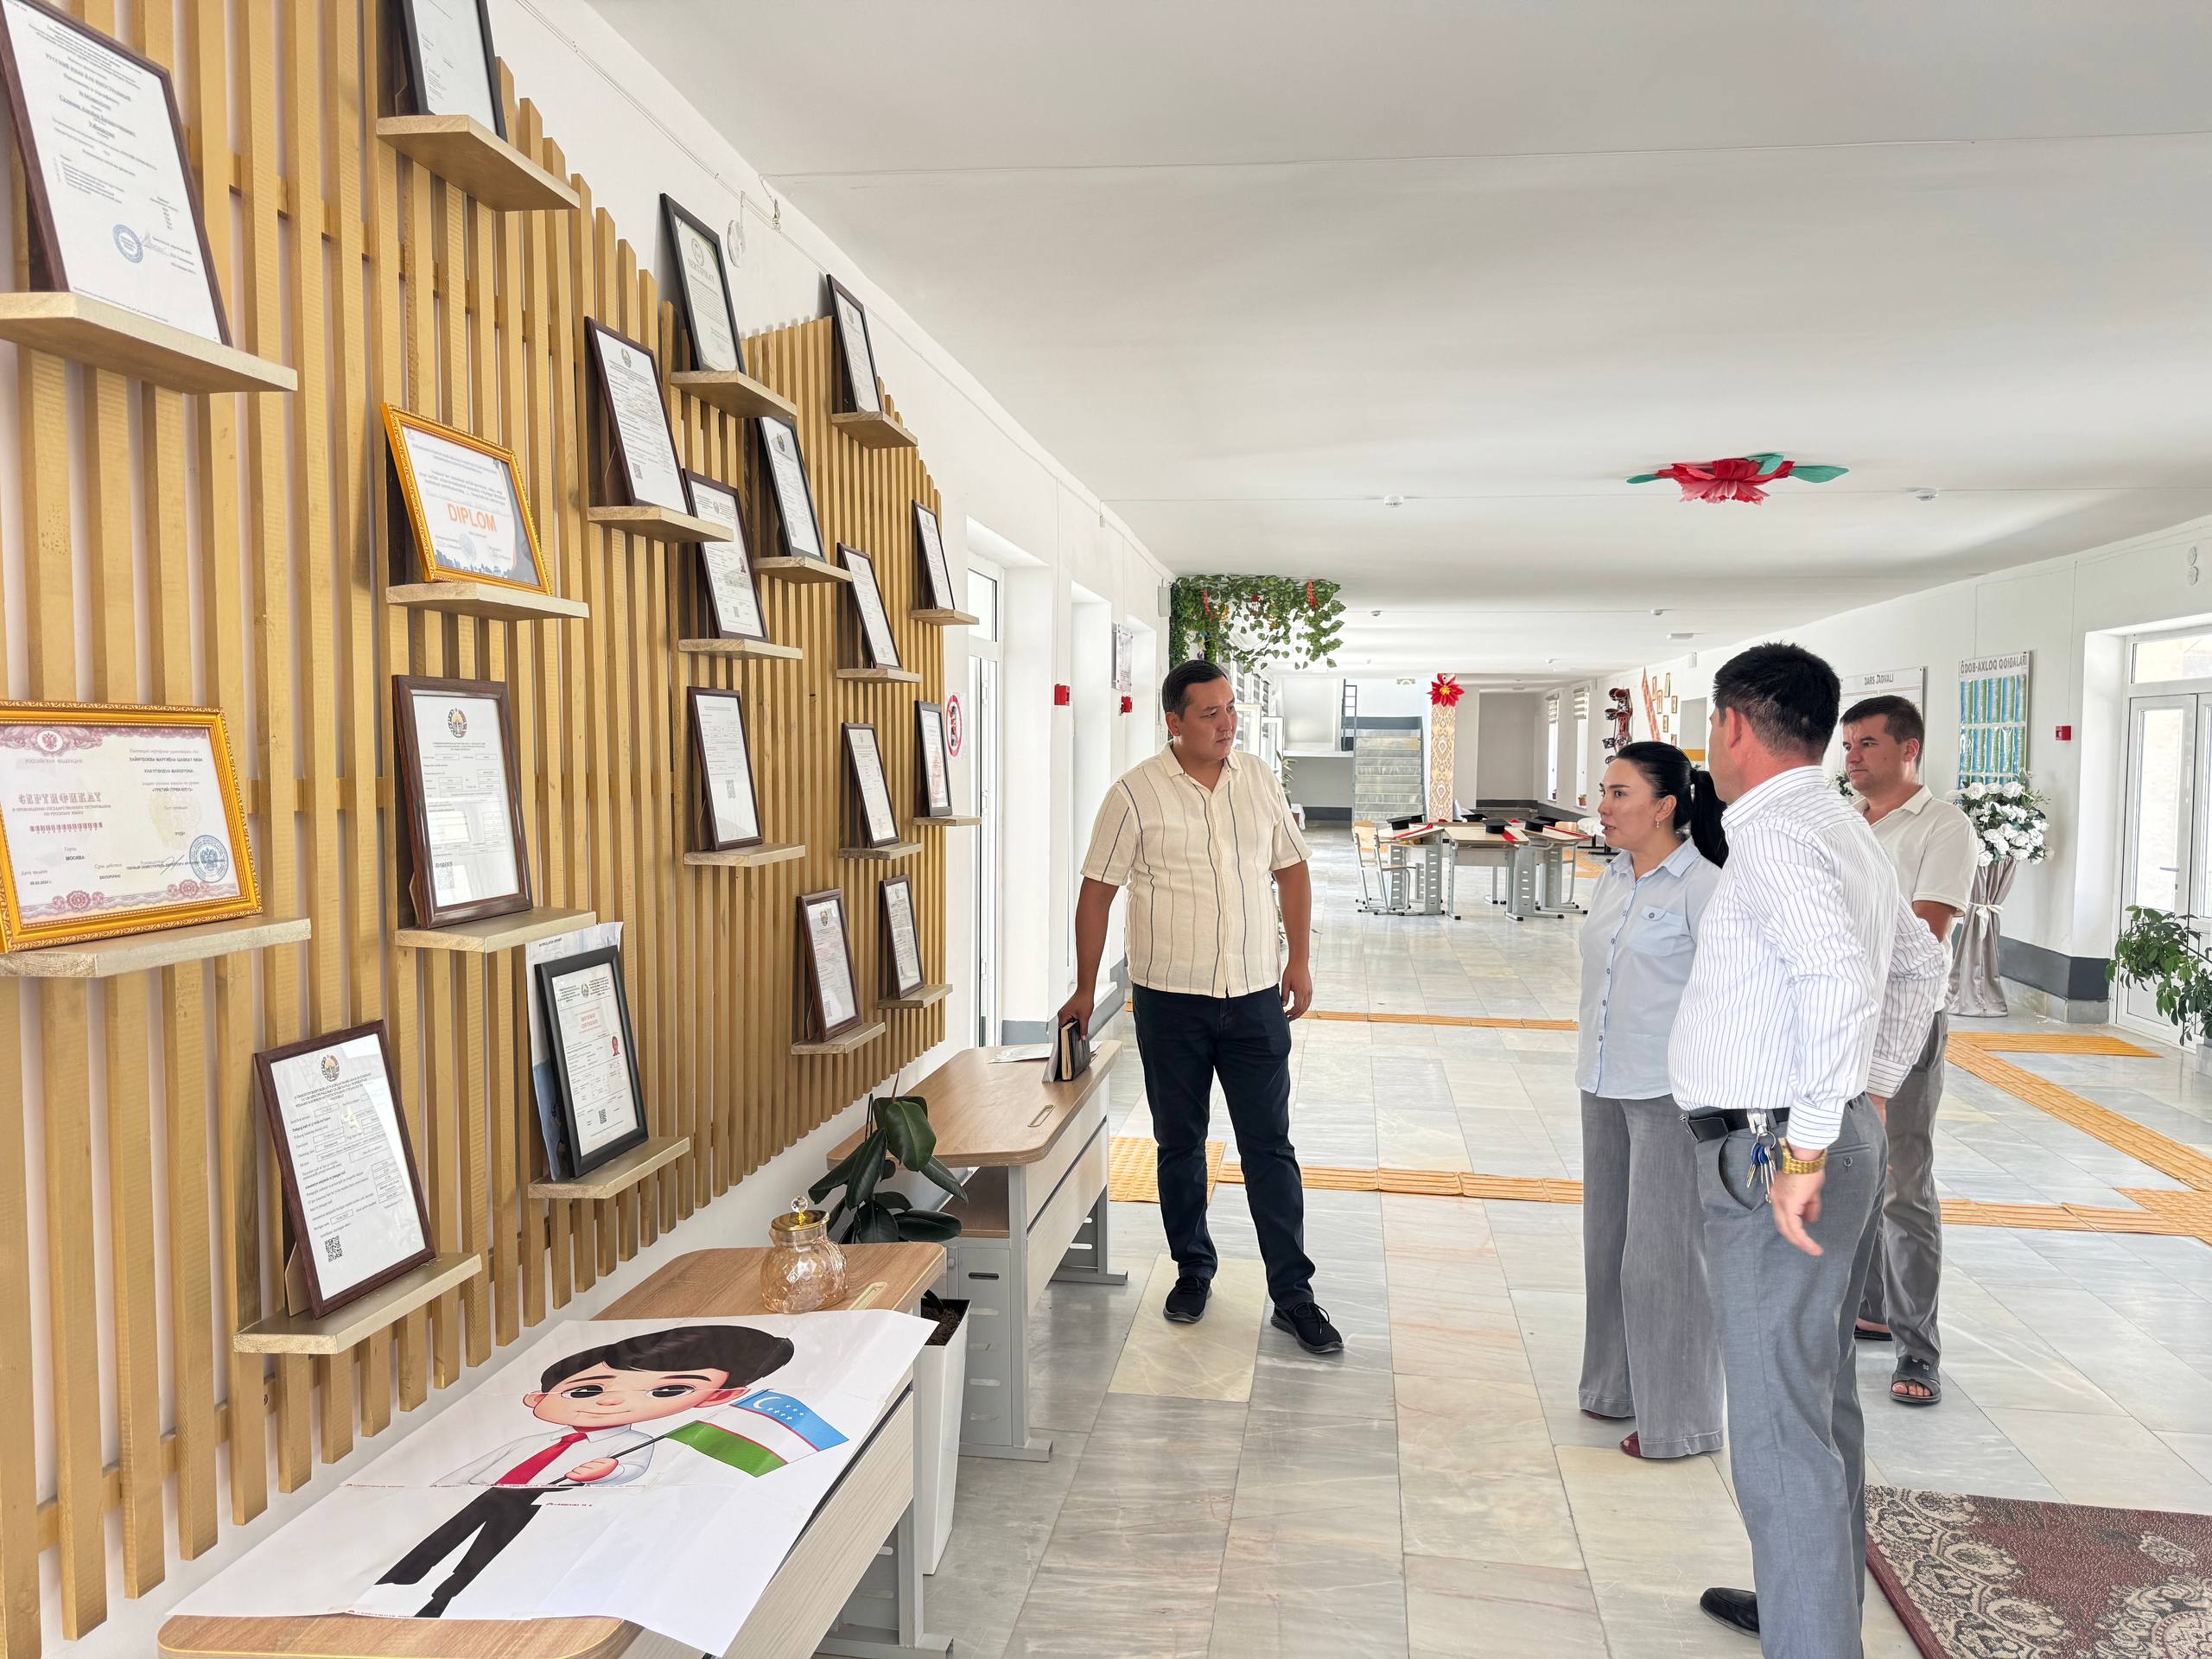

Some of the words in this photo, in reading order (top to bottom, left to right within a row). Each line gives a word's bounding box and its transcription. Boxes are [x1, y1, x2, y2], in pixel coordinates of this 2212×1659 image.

[447, 503, 498, 532] DIPLOM
[1865, 677, 1875, 685] DARS
[1876, 674, 1894, 684] JADVALI
[18, 791, 102, 805] СЕРТИФИКАТ
